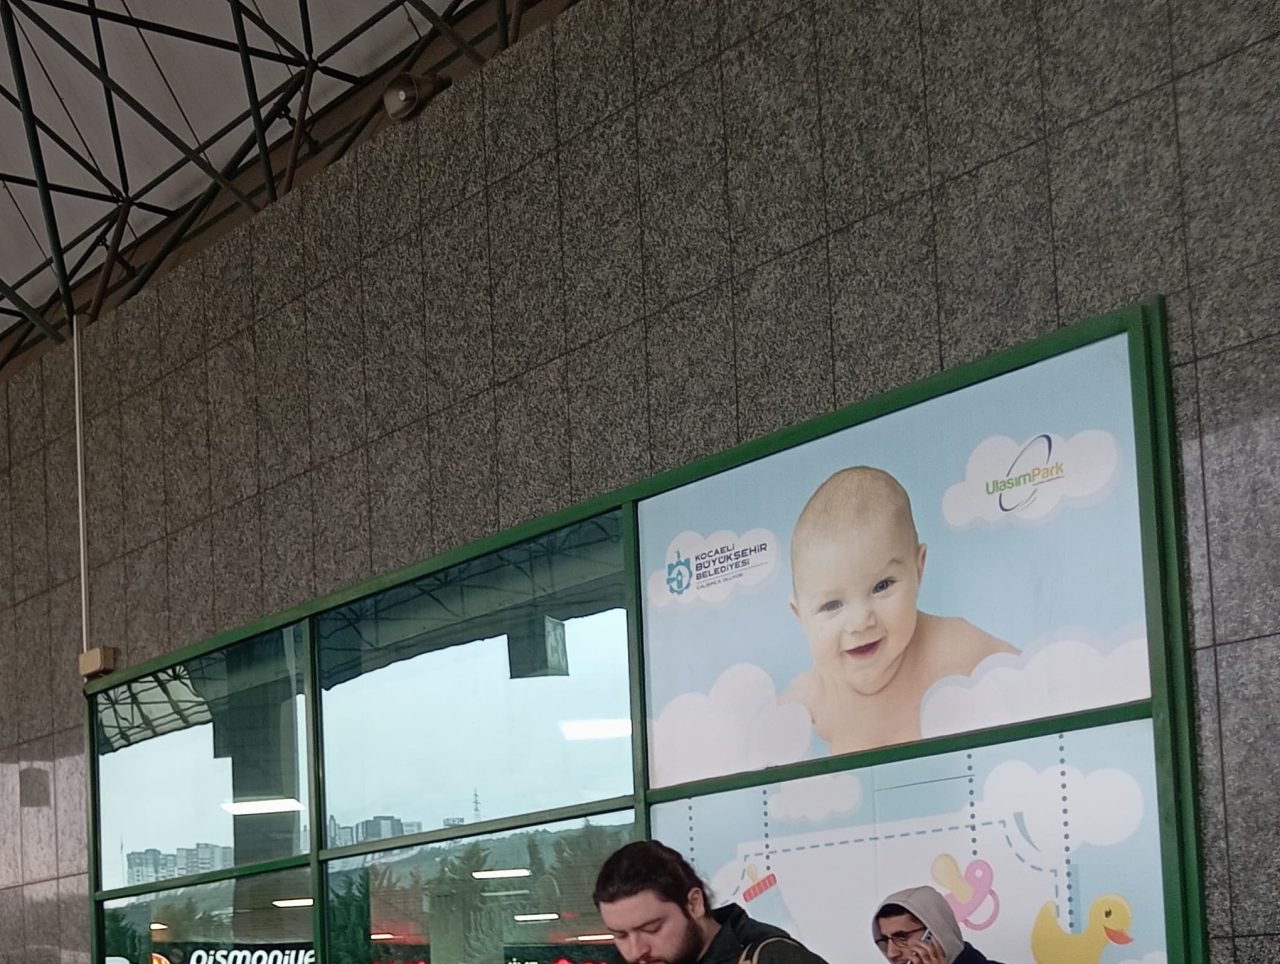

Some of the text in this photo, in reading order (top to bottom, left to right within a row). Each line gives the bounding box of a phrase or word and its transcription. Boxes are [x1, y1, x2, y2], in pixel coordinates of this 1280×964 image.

[695, 543, 735, 561] KOCAELİ
[695, 543, 768, 572] BÜYÜKŞEHİR
[695, 559, 750, 581] BELEDİYESİ
